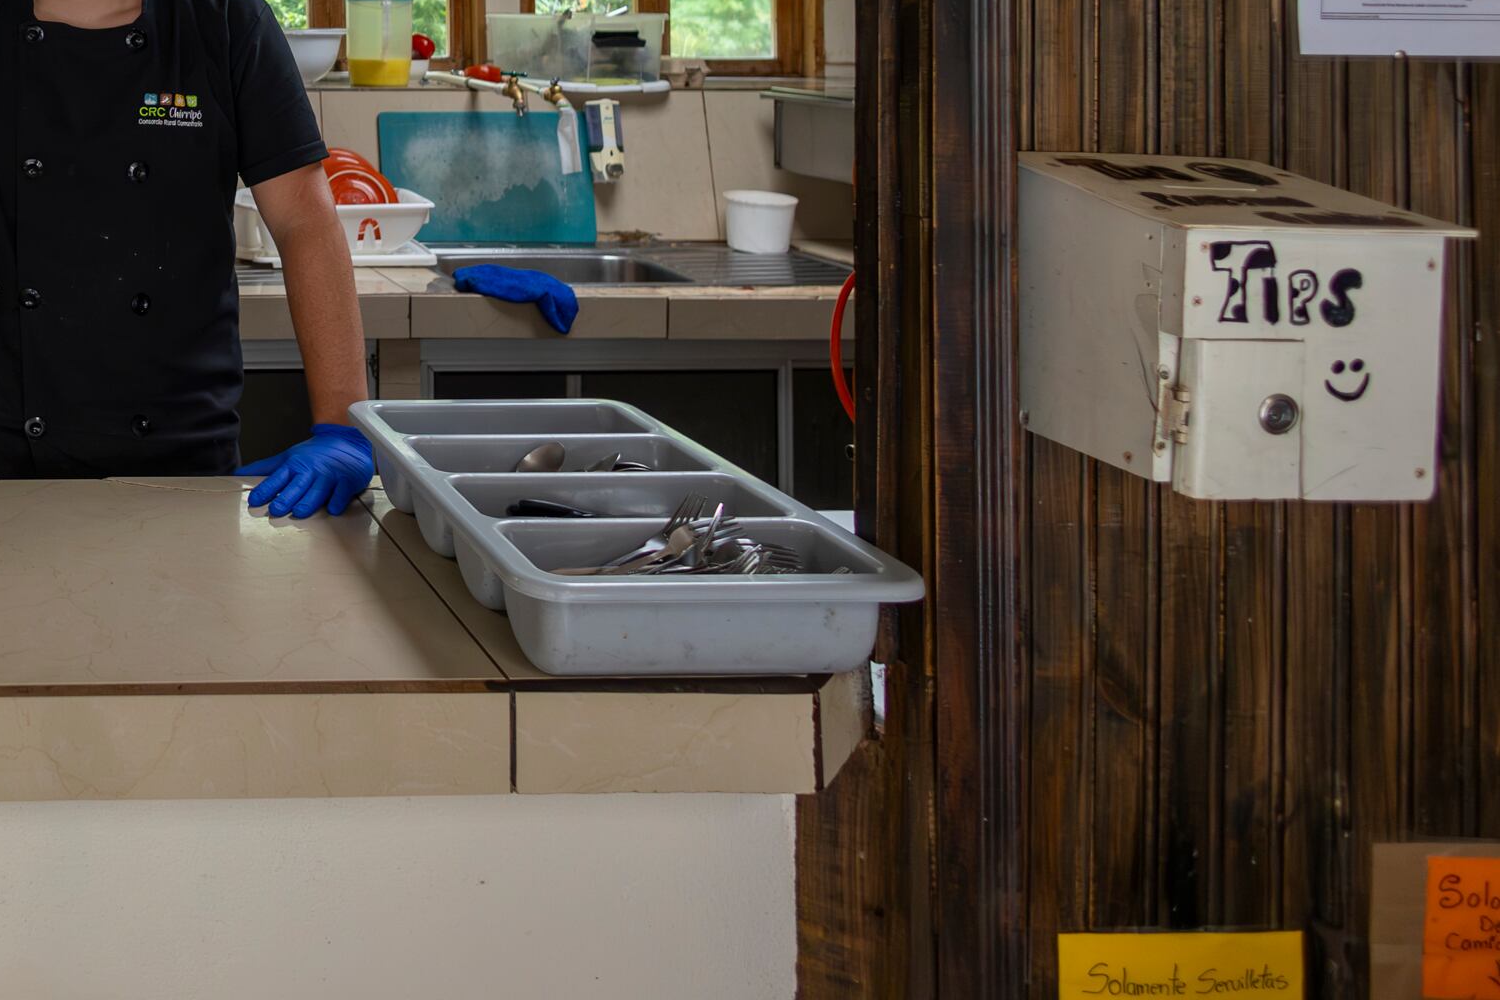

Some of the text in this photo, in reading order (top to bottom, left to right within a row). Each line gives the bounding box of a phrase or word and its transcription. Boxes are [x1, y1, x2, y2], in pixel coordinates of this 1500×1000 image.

[139, 106, 203, 120] CRC Chirripó
[138, 118, 164, 126] Consorcio
[1081, 962, 1290, 997] Solamente Servilletas
